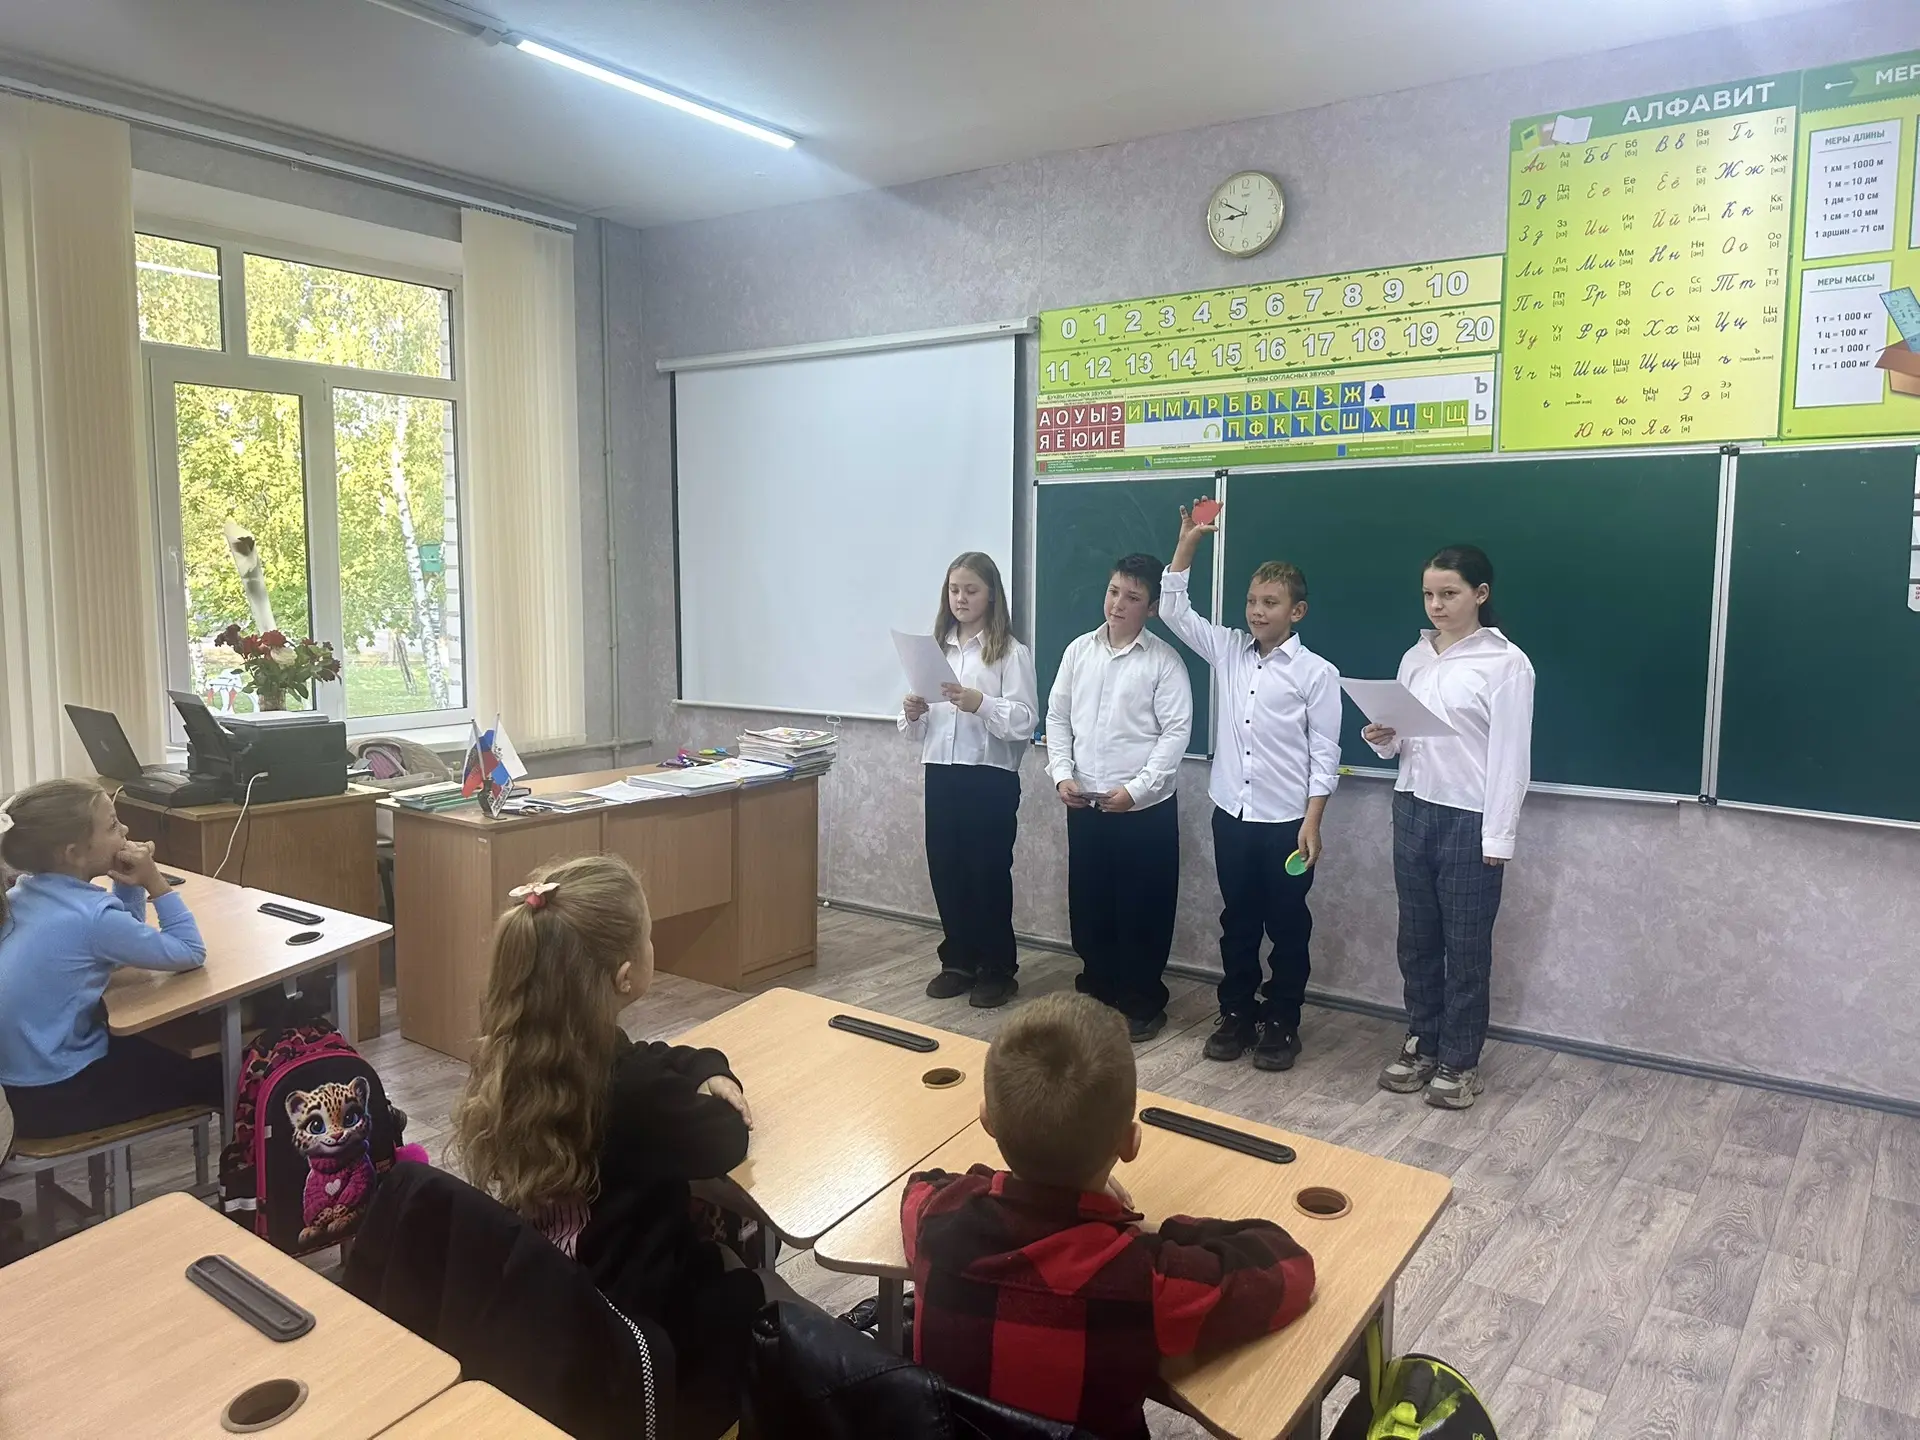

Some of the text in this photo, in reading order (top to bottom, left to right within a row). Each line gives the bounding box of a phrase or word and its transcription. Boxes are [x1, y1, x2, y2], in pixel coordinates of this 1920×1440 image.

[1622, 82, 1776, 126] АЛФАВИТ
[1825, 129, 1885, 146] МЕРЫ ДЛИНЫ
[1853, 159, 1874, 169] 1000
[1242, 179, 1250, 189] 12
[1852, 177, 1863, 186] 10
[1865, 176, 1878, 185] дм
[1229, 185, 1236, 196] 11
[1268, 190, 1275, 200] 2
[1831, 197, 1844, 205] дм
[1854, 193, 1865, 201] 10
[1867, 192, 1879, 200] см
[1272, 204, 1278, 214] 3
[1214, 213, 1221, 223] 9
[1830, 213, 1842, 221] см
[1851, 209, 1862, 218] 10
[1864, 209, 1878, 217] мм
[1267, 220, 1273, 229] 4
[1218, 228, 1225, 238] 8
[1822, 228, 1850, 239] аршин
[1860, 225, 1870, 233] 71
[1873, 224, 1885, 232] см
[1229, 236, 1235, 247] 7
[1242, 238, 1249, 248] 6
[1257, 233, 1262, 242] 5
[1817, 273, 1875, 287] МЕРЫ МАССЫ
[1061, 271, 1469, 339] 0 1 2 3 4 5 6 7 8 9 10
[1844, 312, 1861, 321] 000
[1841, 328, 1856, 337] 100
[1046, 316, 1494, 383] 11 12 13 14 15 16 17 18 19 20
[1846, 344, 1864, 352] 000
[1840, 360, 1857, 369] 000
[1269, 373, 1309, 382] СОГЛАСНЫХ
[1309, 370, 1336, 378] ЗВУКОВ
[1474, 376, 1488, 394] Ъ
[1128, 386, 1361, 420] Й Н М Л Р Б В Г Д З Ж
[1039, 405, 1122, 427] А О У Ы Э
[1475, 404, 1487, 421] Ь
[1228, 405, 1466, 438] П Ф К Т С Ш Х Ц Ч Щ
[1040, 430, 1121, 450] Я Ё Ю И Е
